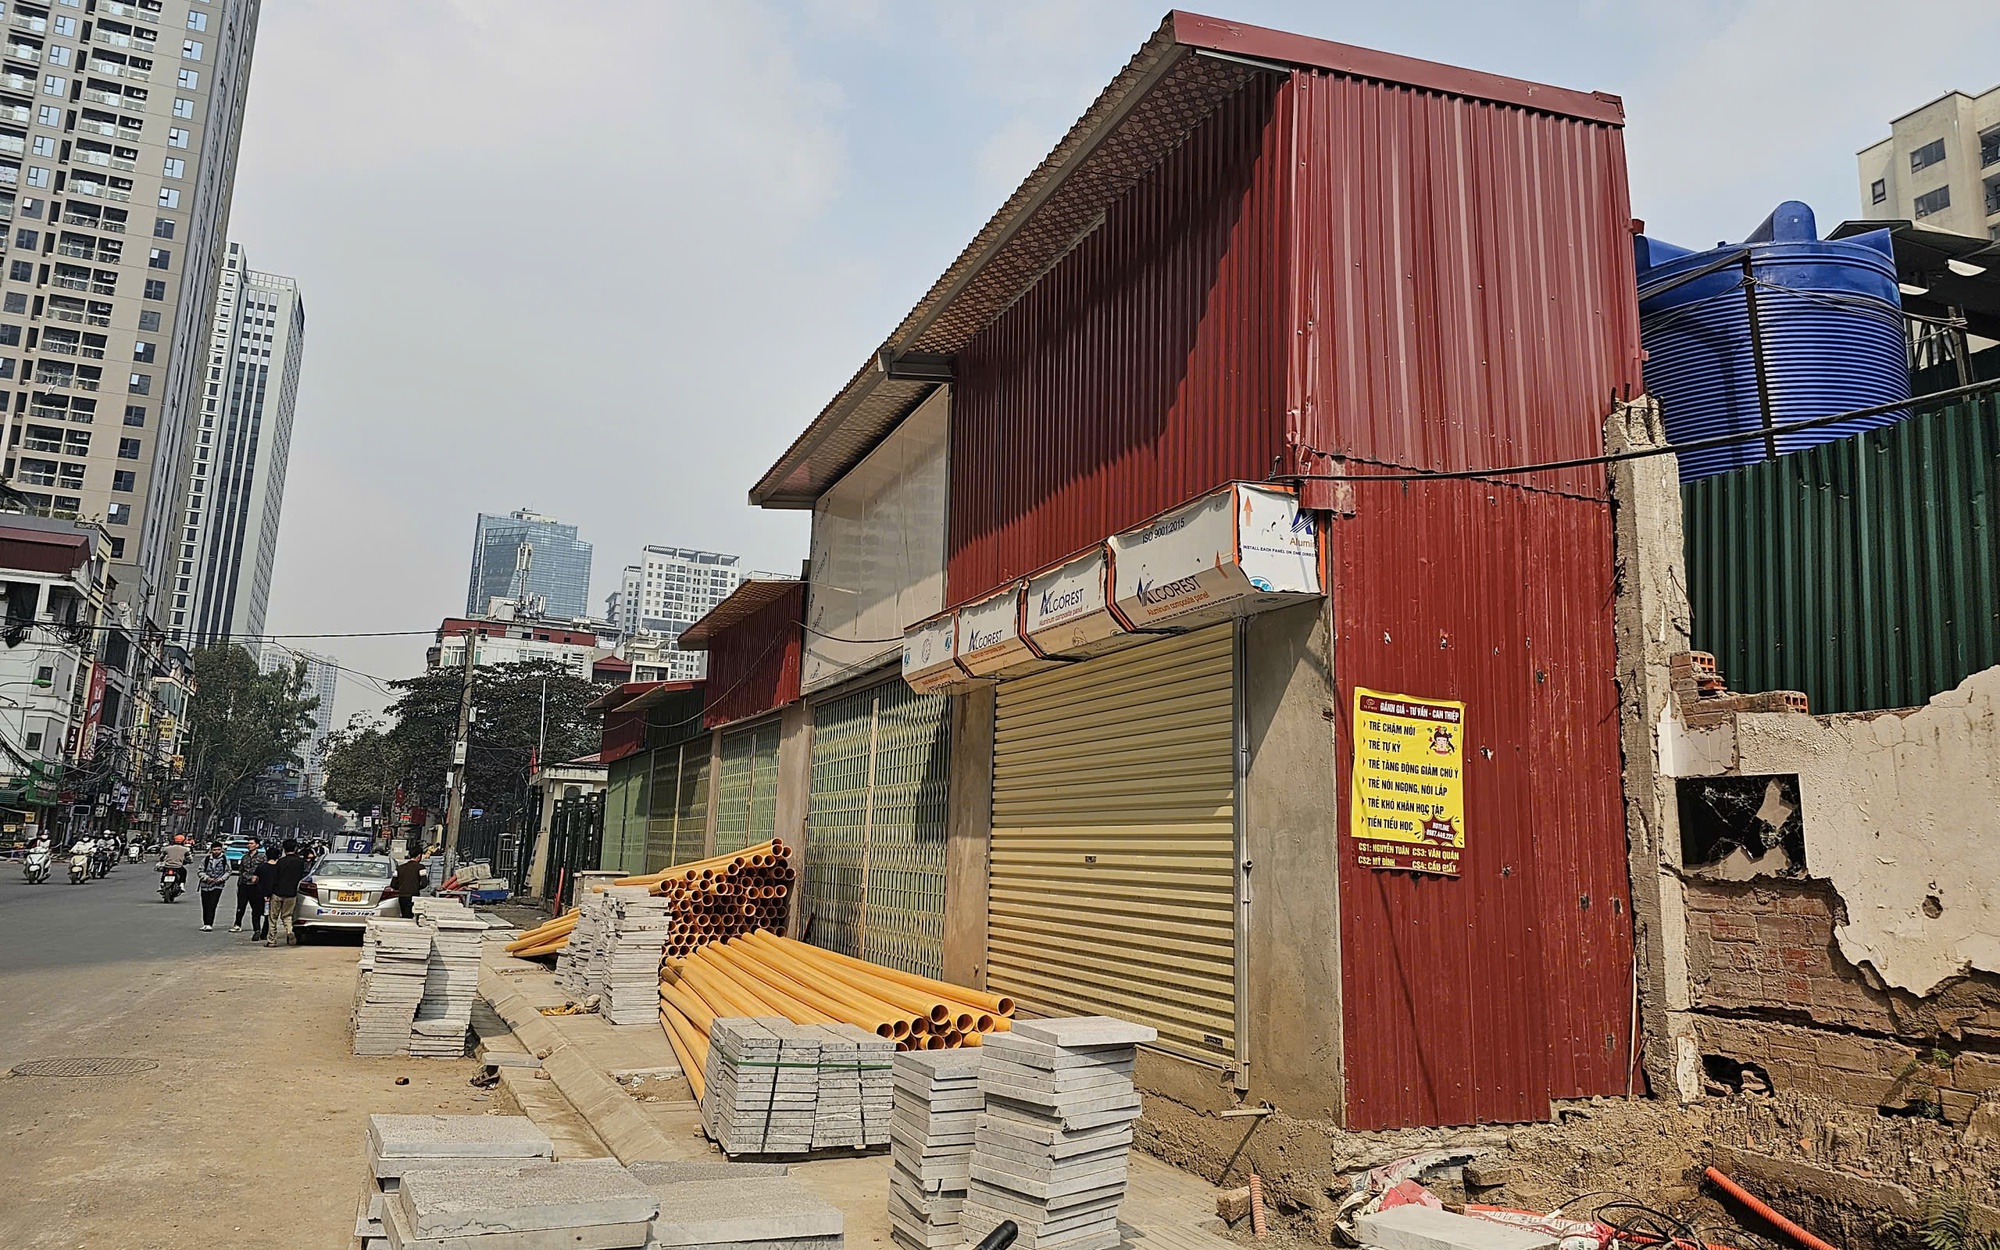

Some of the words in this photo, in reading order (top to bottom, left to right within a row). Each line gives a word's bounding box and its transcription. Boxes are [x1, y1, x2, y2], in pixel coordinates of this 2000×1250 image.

[1142, 531, 1154, 544] ISO
[1154, 518, 1185, 539] 9001:2015
[1136, 575, 1202, 607] ALCOREST
[1040, 588, 1084, 616] ALCOREST
[1147, 604, 1170, 616] Aluminum
[1170, 596, 1196, 607] composite
[1194, 591, 1210, 602] panel
[968, 628, 1002, 652] ALCOREST
[1380, 701, 1395, 713] ĐÁNH
[1396, 702, 1405, 714] GIÁ
[1432, 710, 1443, 719] CAN
[1445, 710, 1459, 722] THIỆP
[1369, 719, 1381, 731] TRẺ
[1382, 723, 1402, 736] CHẬM
[1404, 724, 1416, 736] NÓI
[1368, 738, 1380, 750] TRẺ
[1382, 741, 1392, 753] TỰ
[1392, 740, 1401, 752] KỶ
[1368, 757, 1380, 769] TRẺ
[1382, 760, 1399, 772] TĂNG
[1401, 763, 1419, 775] ĐỘNG
[1421, 764, 1438, 776] GIẢM
[1440, 767, 1453, 778] CHÚ
[1455, 767, 1458, 779] Ý
[1368, 776, 1380, 789] TRẺ
[1382, 779, 1393, 790] NÓI
[1395, 782, 1419, 794] NGỌNG,
[1421, 783, 1433, 795] NÓI
[1435, 783, 1447, 796] LẮP
[1368, 796, 1379, 808] TRẺ
[1381, 798, 1394, 810] KHÓ
[1397, 800, 1414, 812] KHĂN
[1416, 803, 1429, 815] HỌC
[1431, 804, 1444, 816] TẬP
[1384, 816, 1398, 829] TIỂU
[1400, 822, 1413, 833] HỌC
[353, 842, 365, 852] G7
[1358, 842, 1372, 852] CS1:
[1412, 847, 1427, 856] CS3:
[1428, 848, 1441, 858] VĂN
[1442, 850, 1459, 860] QUÁN
[1358, 856, 1371, 864] CS2:
[1412, 861, 1427, 870] CS4:
